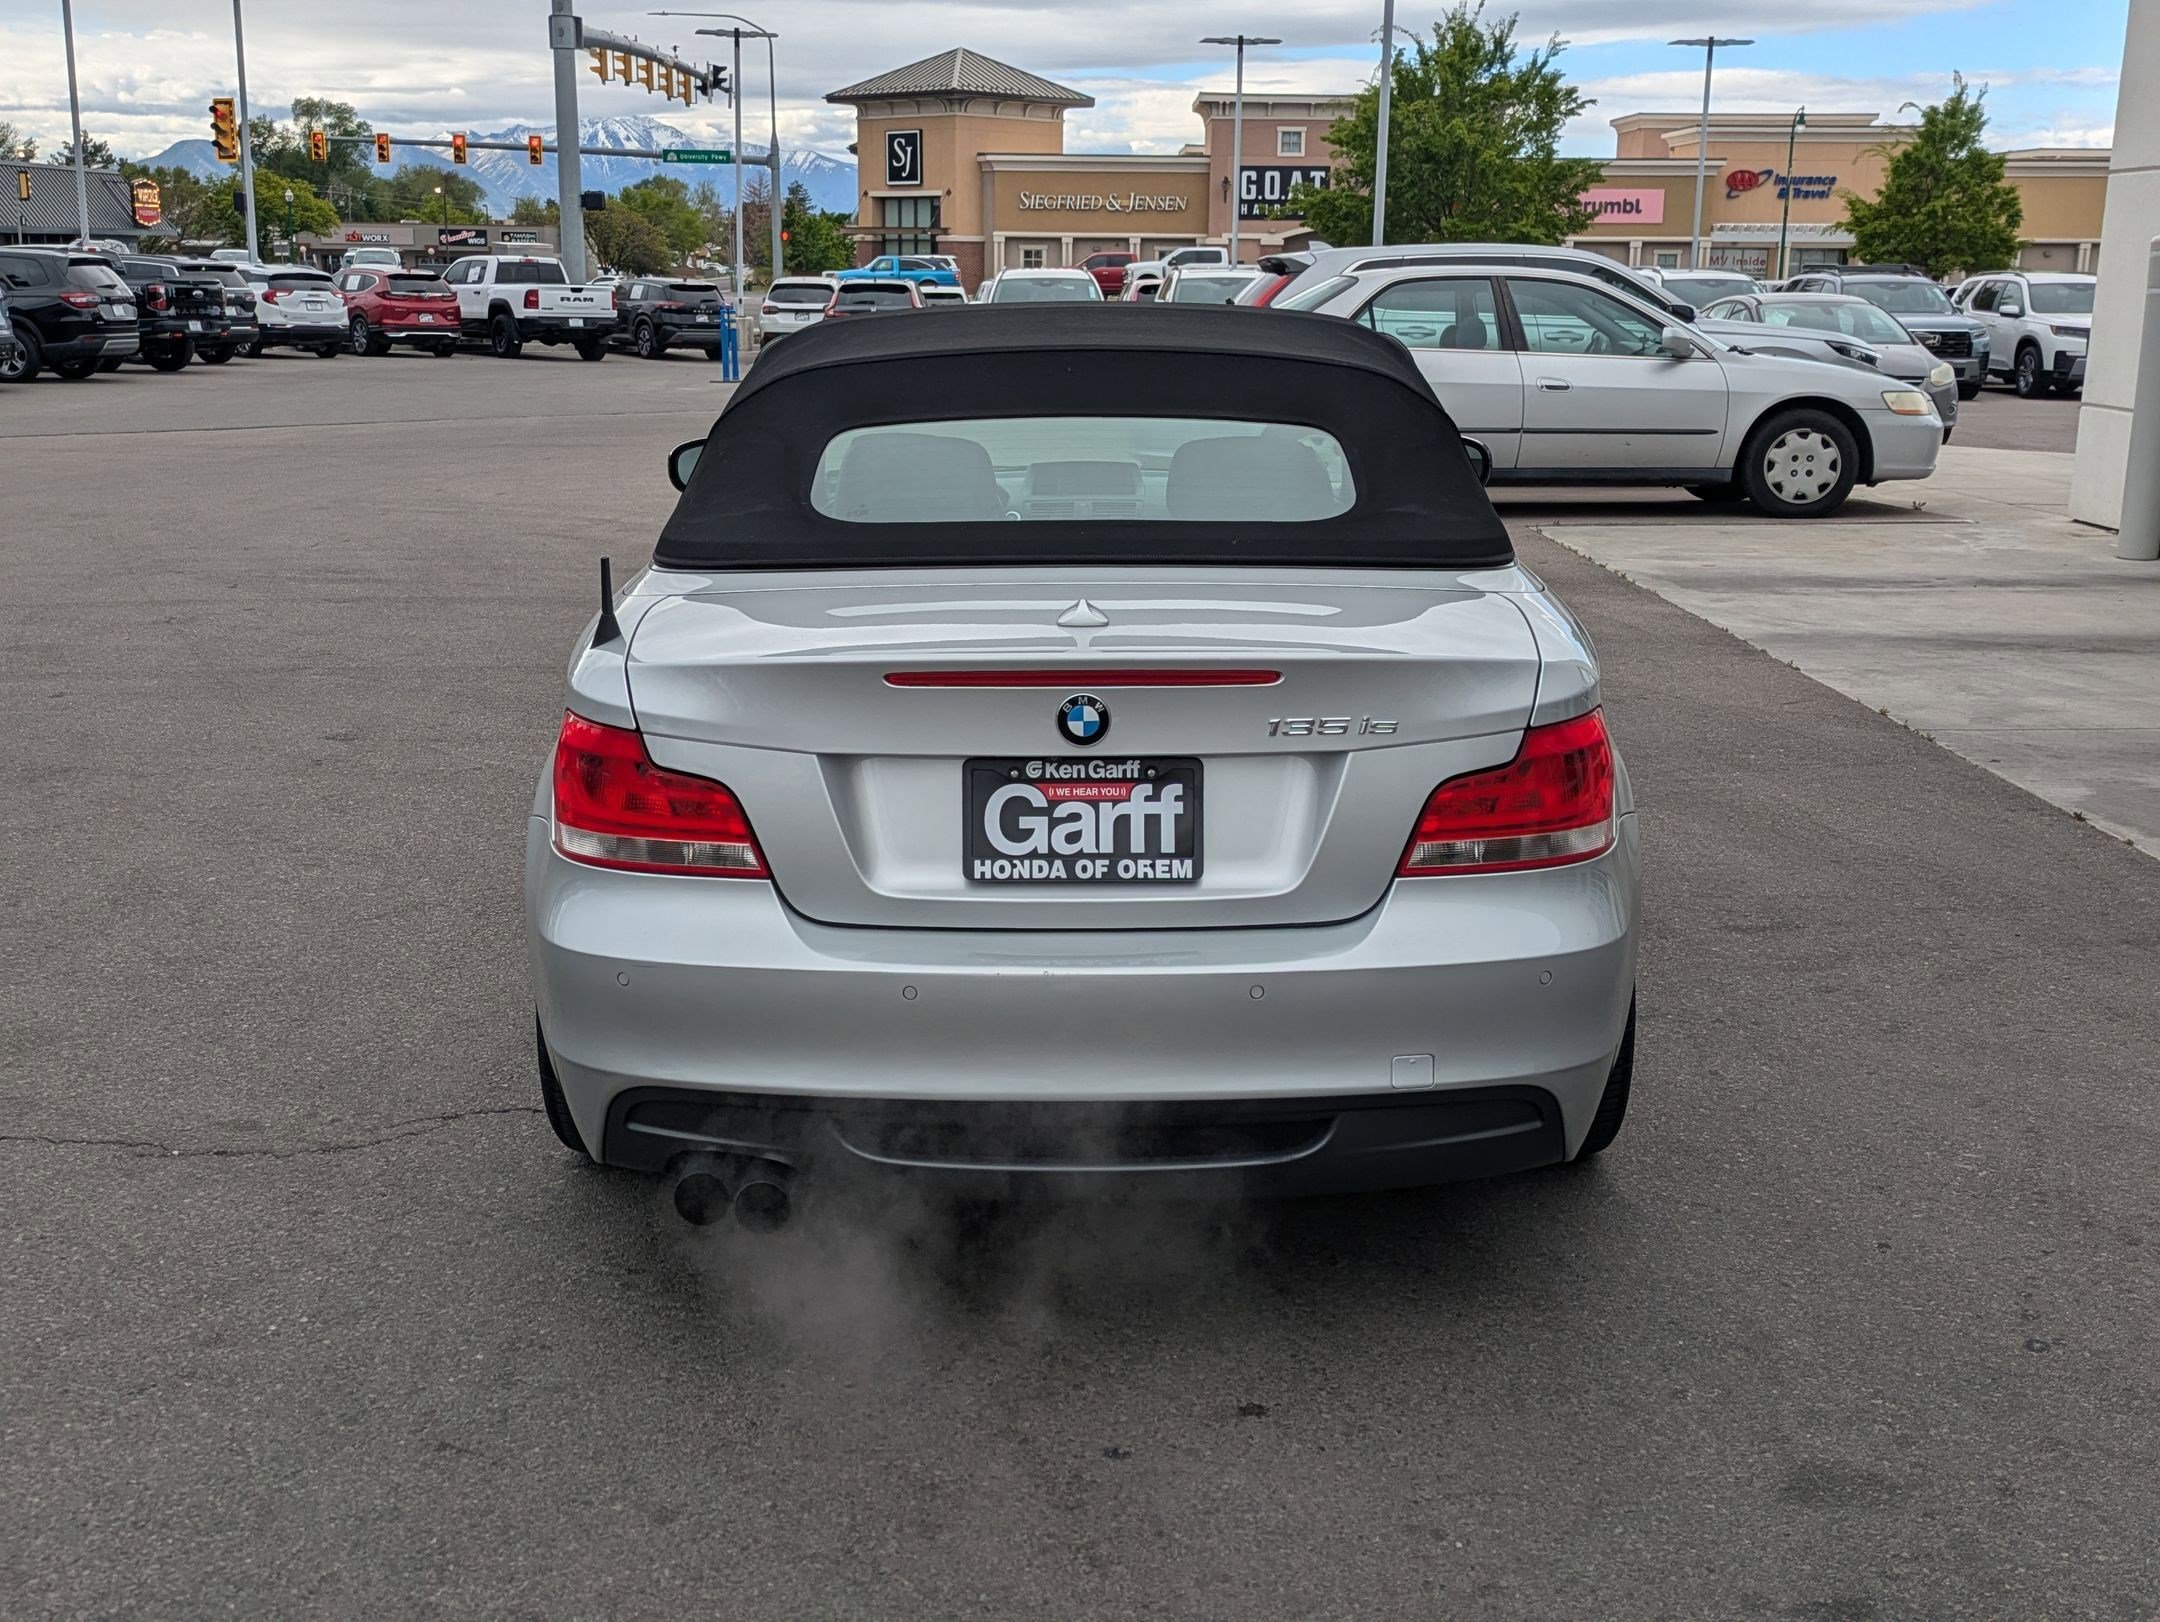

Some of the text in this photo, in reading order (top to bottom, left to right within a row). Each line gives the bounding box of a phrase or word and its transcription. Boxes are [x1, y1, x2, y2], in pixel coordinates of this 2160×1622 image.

[680, 153, 727, 162] University Pkwy
[892, 137, 913, 177] SJ
[1241, 170, 1326, 200] G.O.AT
[1792, 186, 1832, 199] Travel
[1105, 193, 1122, 211] &
[1583, 198, 1642, 214] rumbl
[1709, 255, 1766, 267] MV Inside
[1062, 696, 1105, 713] BMW
[1045, 760, 1140, 779] Ken Garff
[1056, 787, 1120, 796] WE HEAR YOU
[984, 783, 1184, 856] Garff
[974, 860, 1194, 880] HONDA OF OREM
